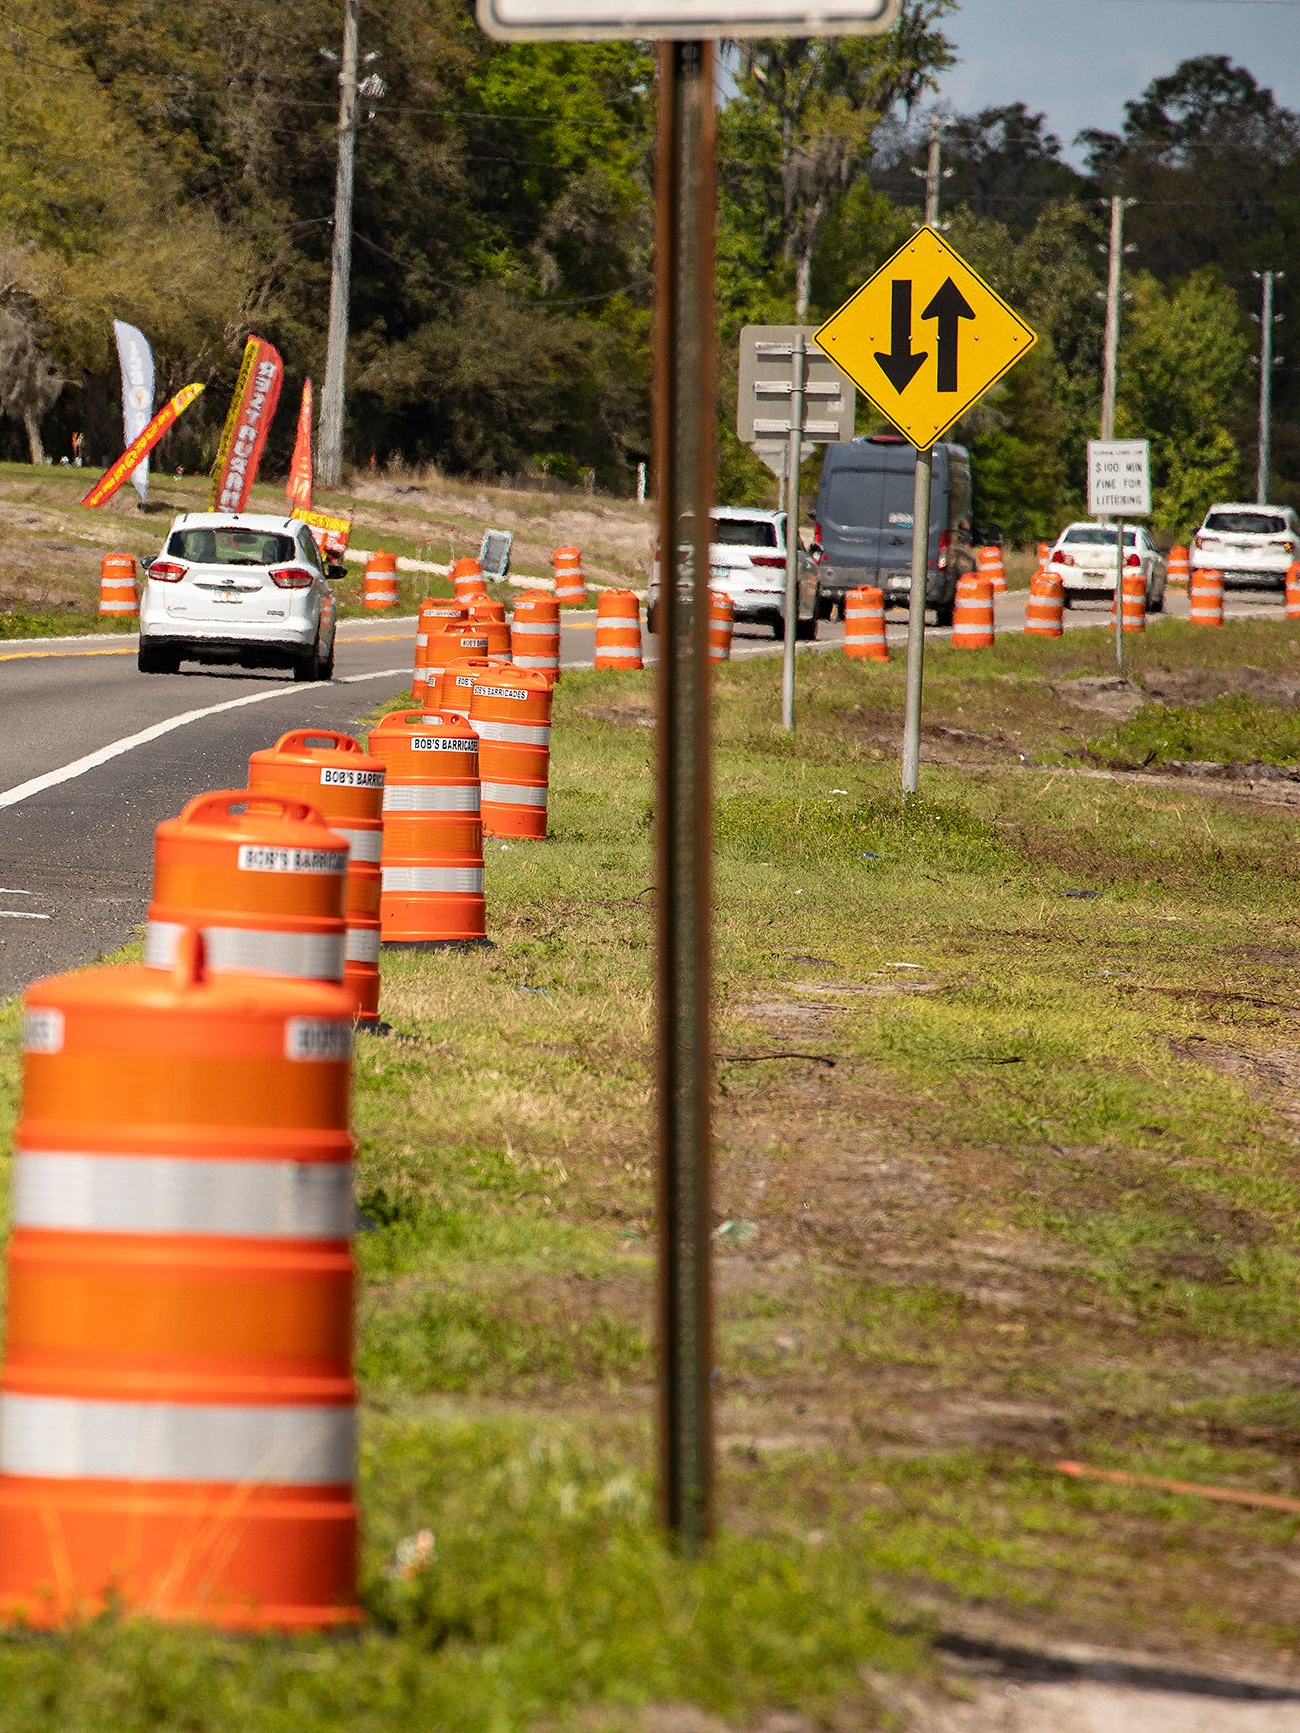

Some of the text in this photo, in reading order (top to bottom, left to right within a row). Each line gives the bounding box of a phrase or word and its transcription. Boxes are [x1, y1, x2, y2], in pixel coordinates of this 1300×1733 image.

[1095, 462, 1142, 474] $100 MIN
[1096, 478, 1142, 489] FINE FOR
[1096, 495, 1142, 506] LITTERING
[487, 687, 526, 699] BARRICADES
[414, 738, 478, 752] BOB'S BARRICADE
[325, 770, 354, 784] BOB'S
[245, 847, 288, 870] BOB'S
